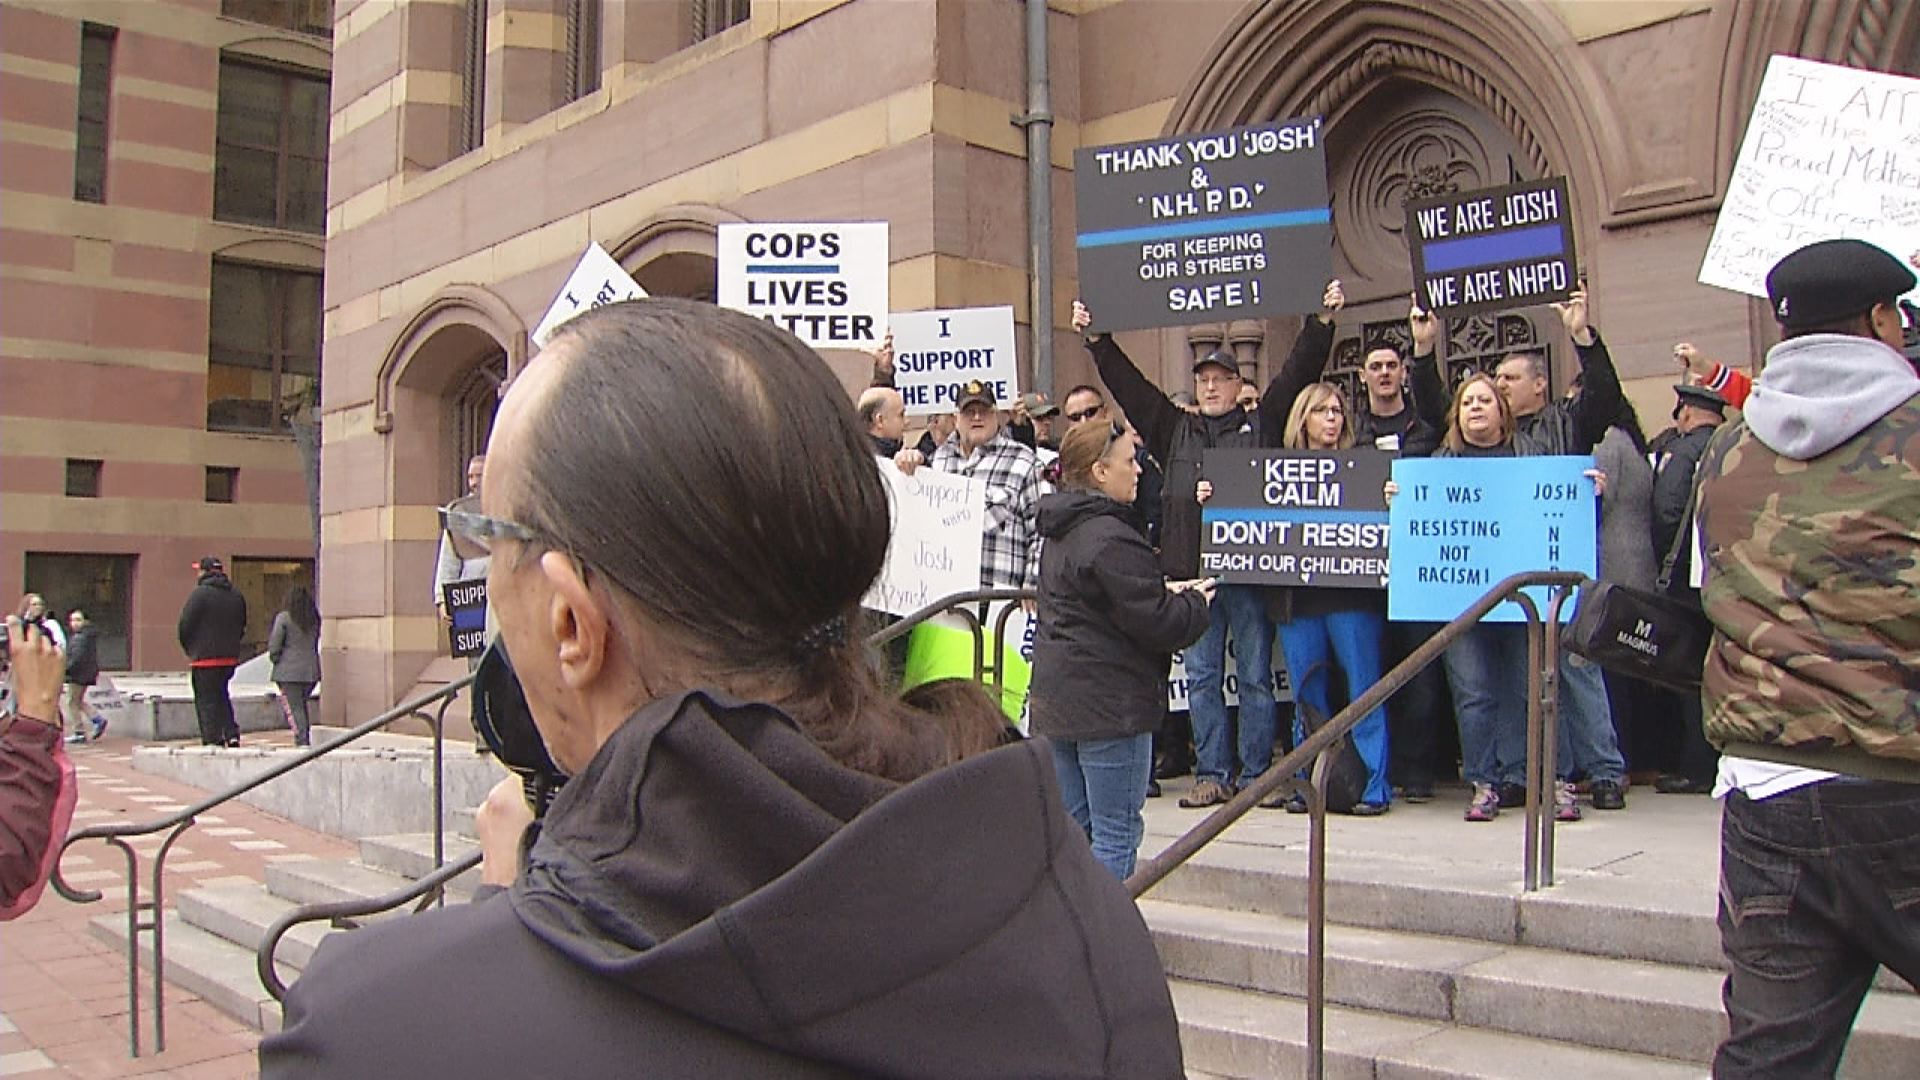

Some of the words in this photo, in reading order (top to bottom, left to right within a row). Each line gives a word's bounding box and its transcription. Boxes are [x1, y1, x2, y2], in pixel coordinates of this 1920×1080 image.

[1095, 143, 1182, 174] THANK
[1186, 136, 1236, 162] YOU
[1190, 167, 1209, 189] &
[1841, 146, 1920, 191] Mothe
[1417, 207, 1449, 239] WE
[1455, 199, 1494, 235] ARE
[1501, 189, 1558, 227] JOSH
[745, 233, 841, 259] COPS
[1142, 243, 1176, 261] FOR
[1184, 233, 1263, 257] KEEPING
[1139, 261, 1178, 280] OUR
[1184, 253, 1266, 276] STREETS
[747, 280, 849, 307] LIVES
[1169, 283, 1243, 311] SAFE
[1426, 277, 1458, 309] WE
[1464, 271, 1503, 304] ARE
[1507, 261, 1567, 297] NHPD
[763, 314, 875, 341] TTER
[938, 318, 951, 338] I
[899, 348, 995, 373] SUPPORT
[896, 384, 929, 406] HE
[935, 381, 1008, 404] POE
[1265, 459, 1336, 483] KEEP
[907, 478, 972, 508] Support
[1264, 482, 1340, 507] CALM
[1414, 484, 1429, 502] IT
[1446, 487, 1482, 503] WAS
[1533, 483, 1578, 500] JOSH
[1211, 521, 1291, 545] DON'T
[1302, 523, 1390, 549] RESIST
[1410, 520, 1501, 537] RESISTING
[1201, 553, 1254, 571] TEACH
[1259, 555, 1296, 573] OUR
[1301, 557, 1389, 576] CHILDREN
[1440, 545, 1470, 562] NOT
[1617, 631, 1659, 656] MAGNUS
